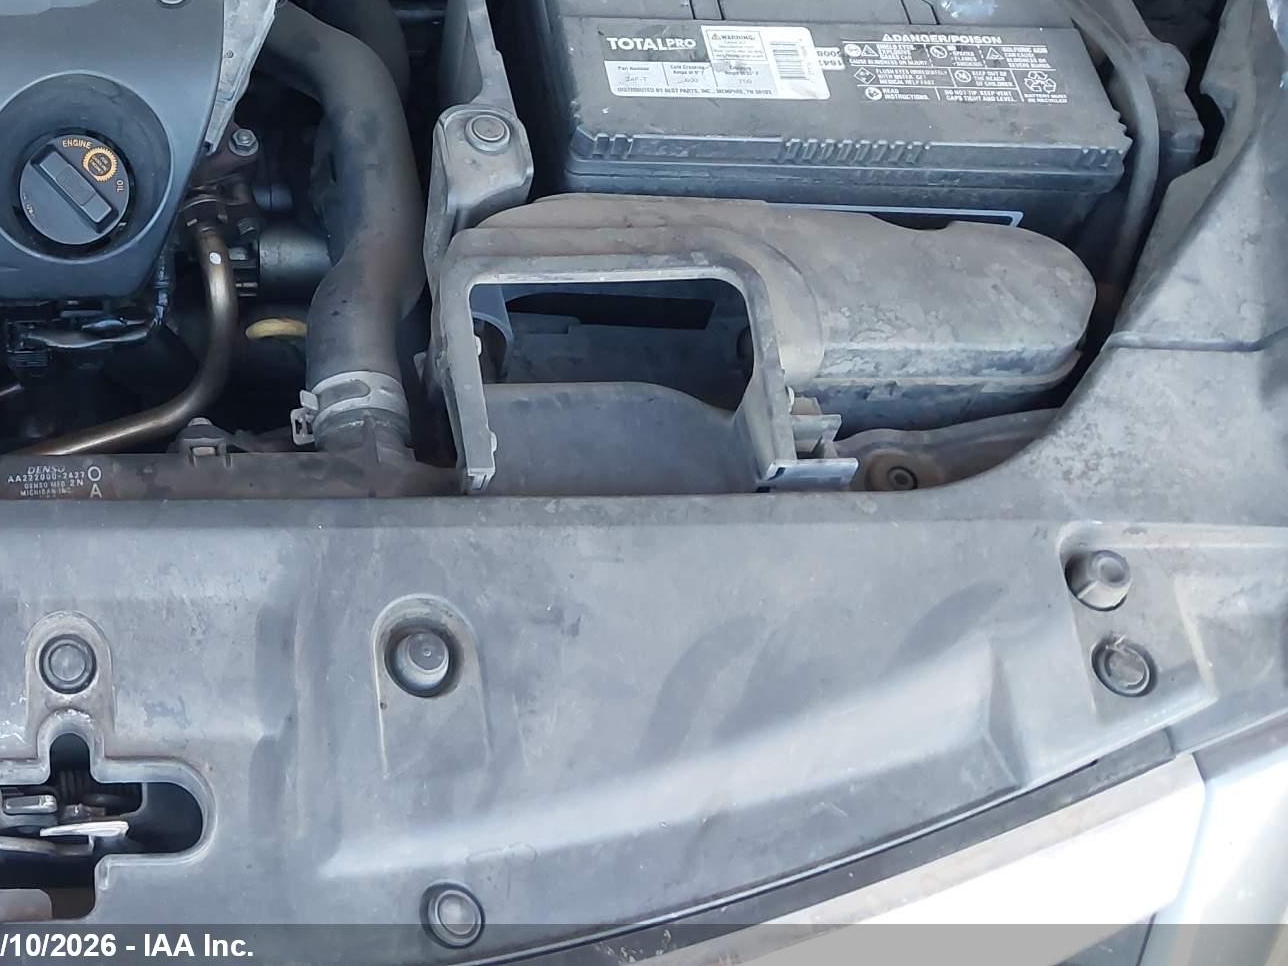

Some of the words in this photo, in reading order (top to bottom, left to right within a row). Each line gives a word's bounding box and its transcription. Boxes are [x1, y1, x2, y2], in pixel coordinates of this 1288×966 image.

[606, 37, 696, 51] TOTALPRO
[895, 34, 1002, 43] DANGER/POISON
[62, 139, 92, 149] ENGINE
[116, 179, 125, 193] OIL
[27, 465, 65, 475] DENSO
[89, 483, 103, 498] A
